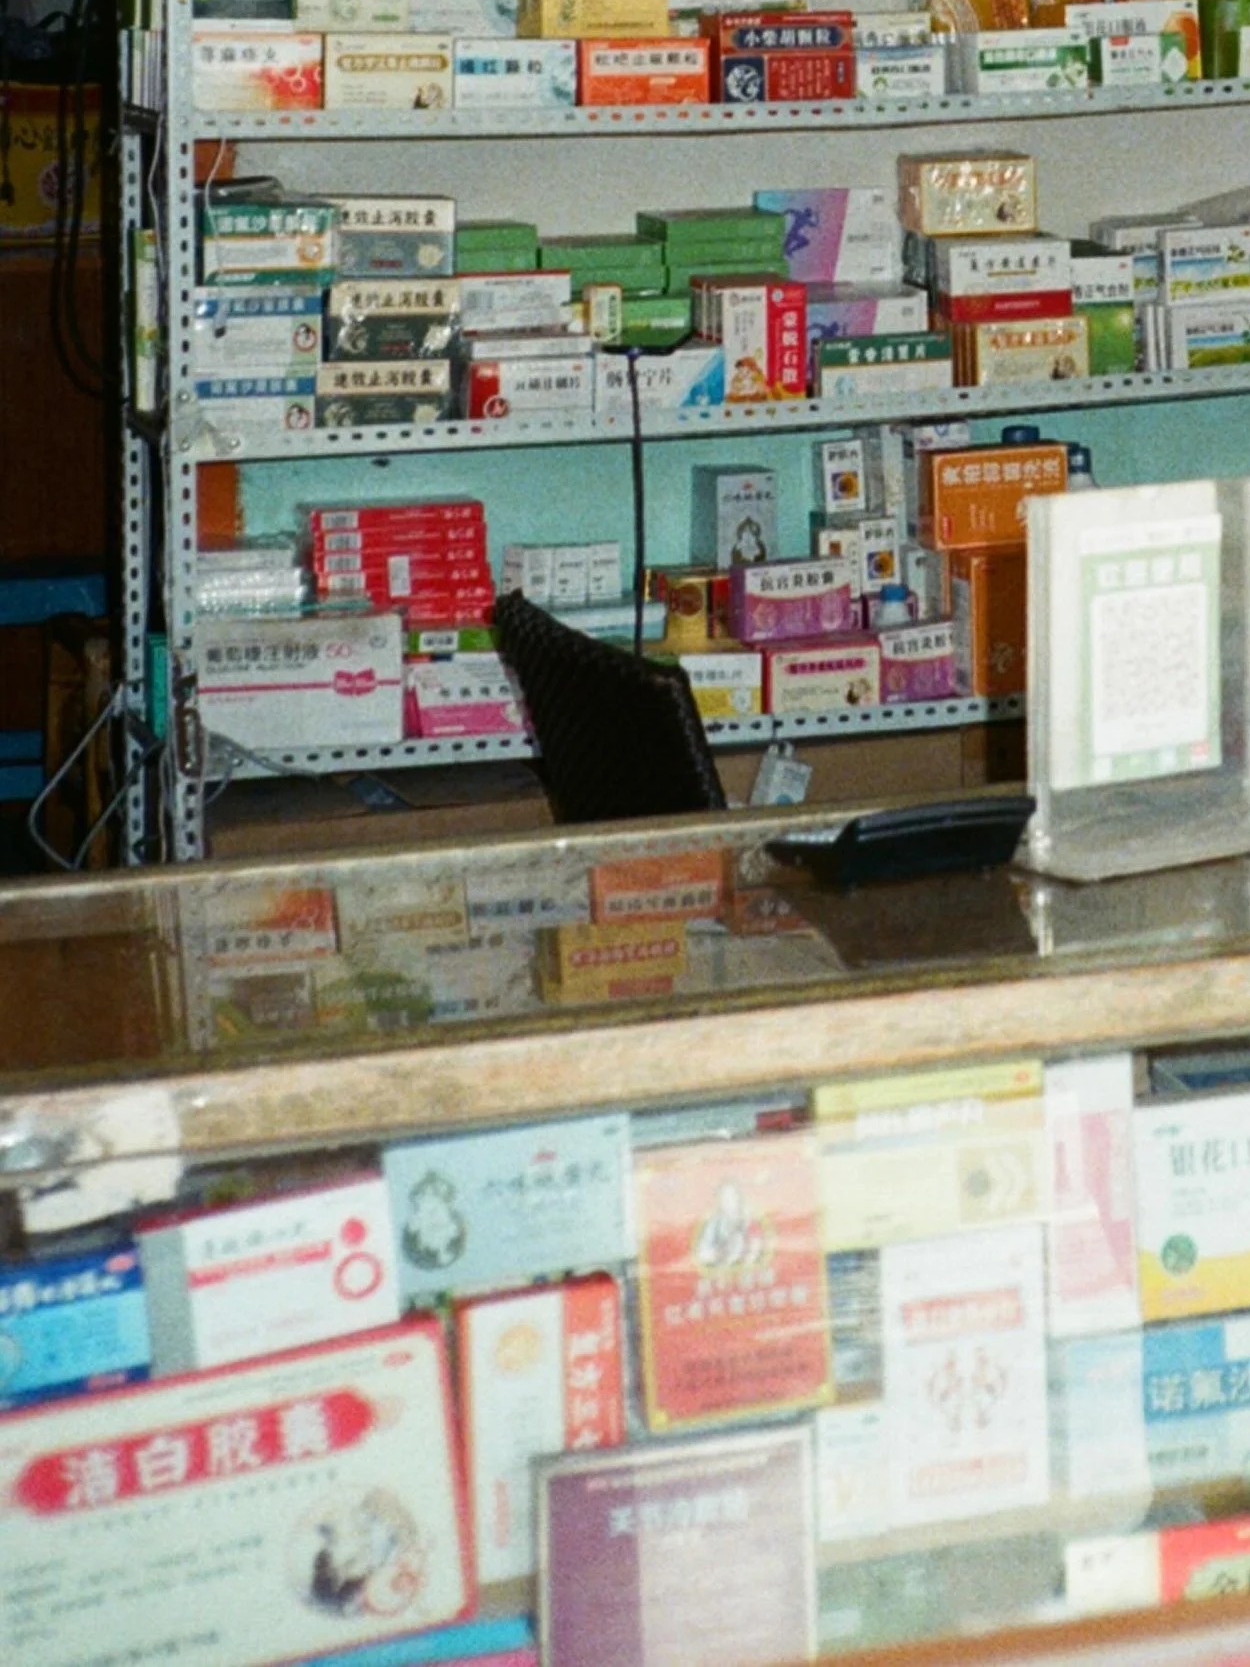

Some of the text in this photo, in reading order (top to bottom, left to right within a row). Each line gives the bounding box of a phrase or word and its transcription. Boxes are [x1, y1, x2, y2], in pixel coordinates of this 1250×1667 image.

[743, 28, 832, 47] 小柴胡颗粒
